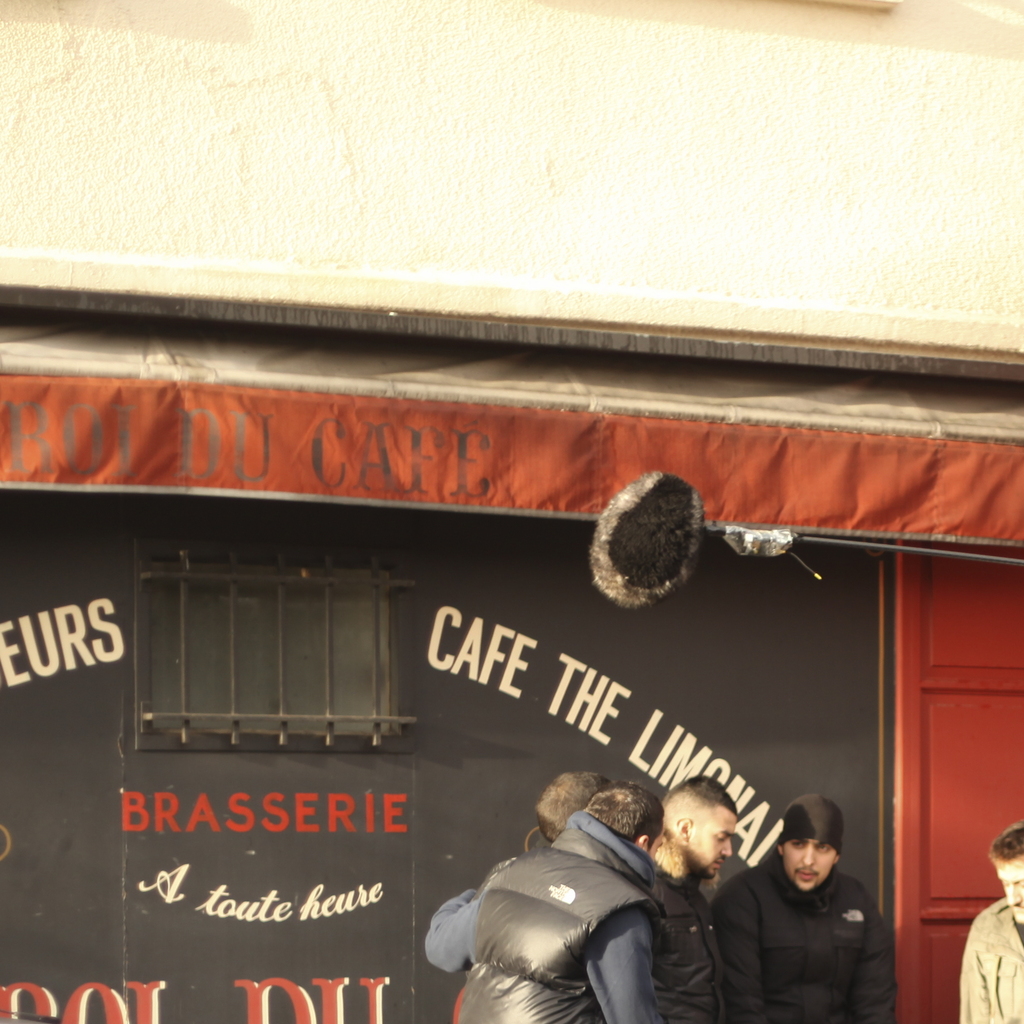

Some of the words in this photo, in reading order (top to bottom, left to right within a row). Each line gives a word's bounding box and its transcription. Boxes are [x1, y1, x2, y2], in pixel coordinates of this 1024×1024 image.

[3, 400, 138, 477] ROI
[174, 407, 275, 483] DU
[311, 417, 492, 498] CAFÉ
[427, 605, 539, 699] CAFE
[548, 652, 633, 746] THE
[121, 791, 408, 833] BRASSERIE
[195, 884, 294, 922] toute
[299, 883, 384, 921] heure
